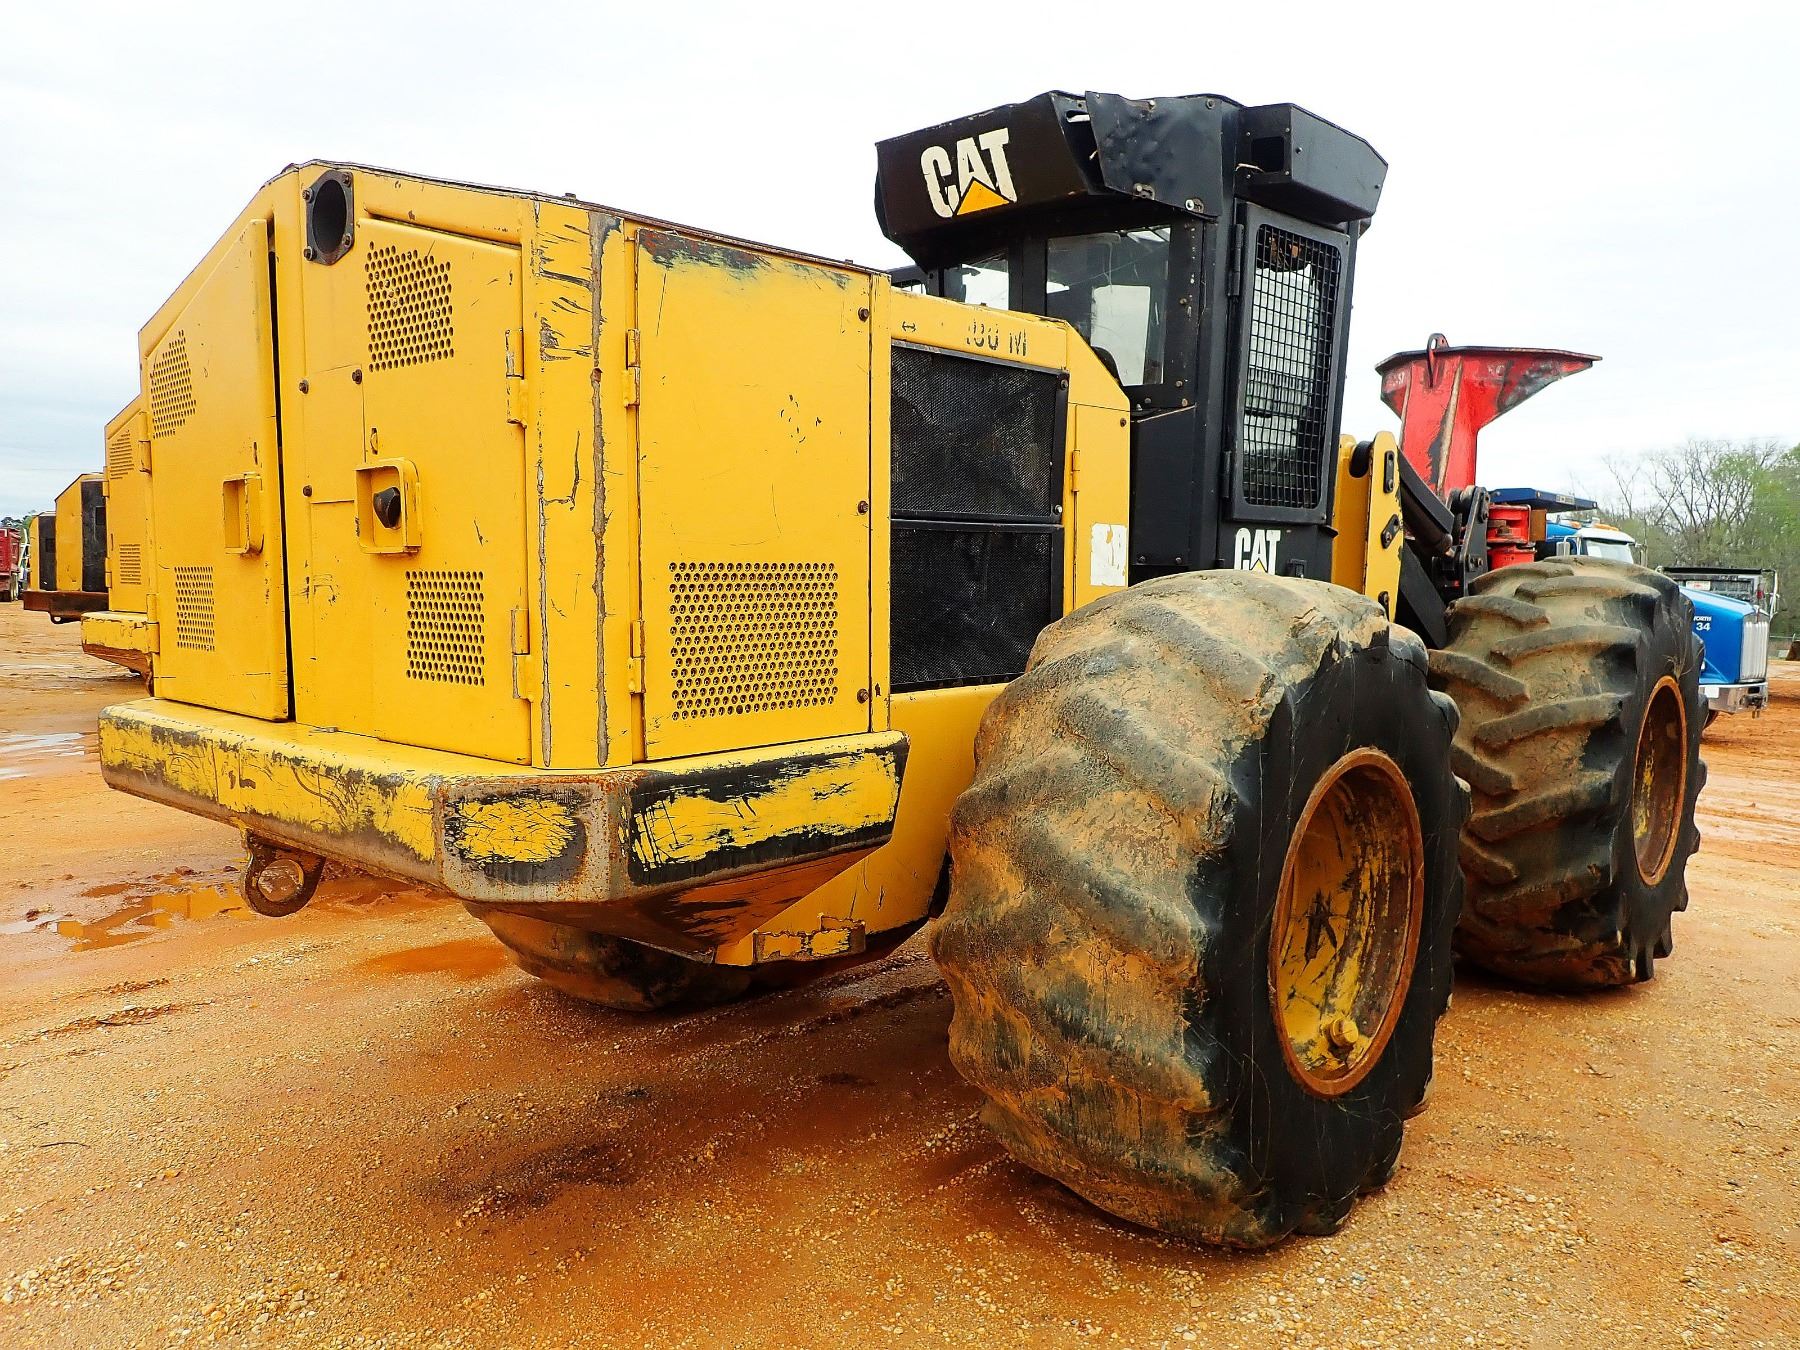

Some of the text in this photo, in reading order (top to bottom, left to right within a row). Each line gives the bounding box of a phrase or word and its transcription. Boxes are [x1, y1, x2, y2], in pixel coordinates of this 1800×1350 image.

[920, 127, 1018, 219] CAT
[1233, 527, 1282, 576] CAT
[1695, 622, 1711, 631] 34
